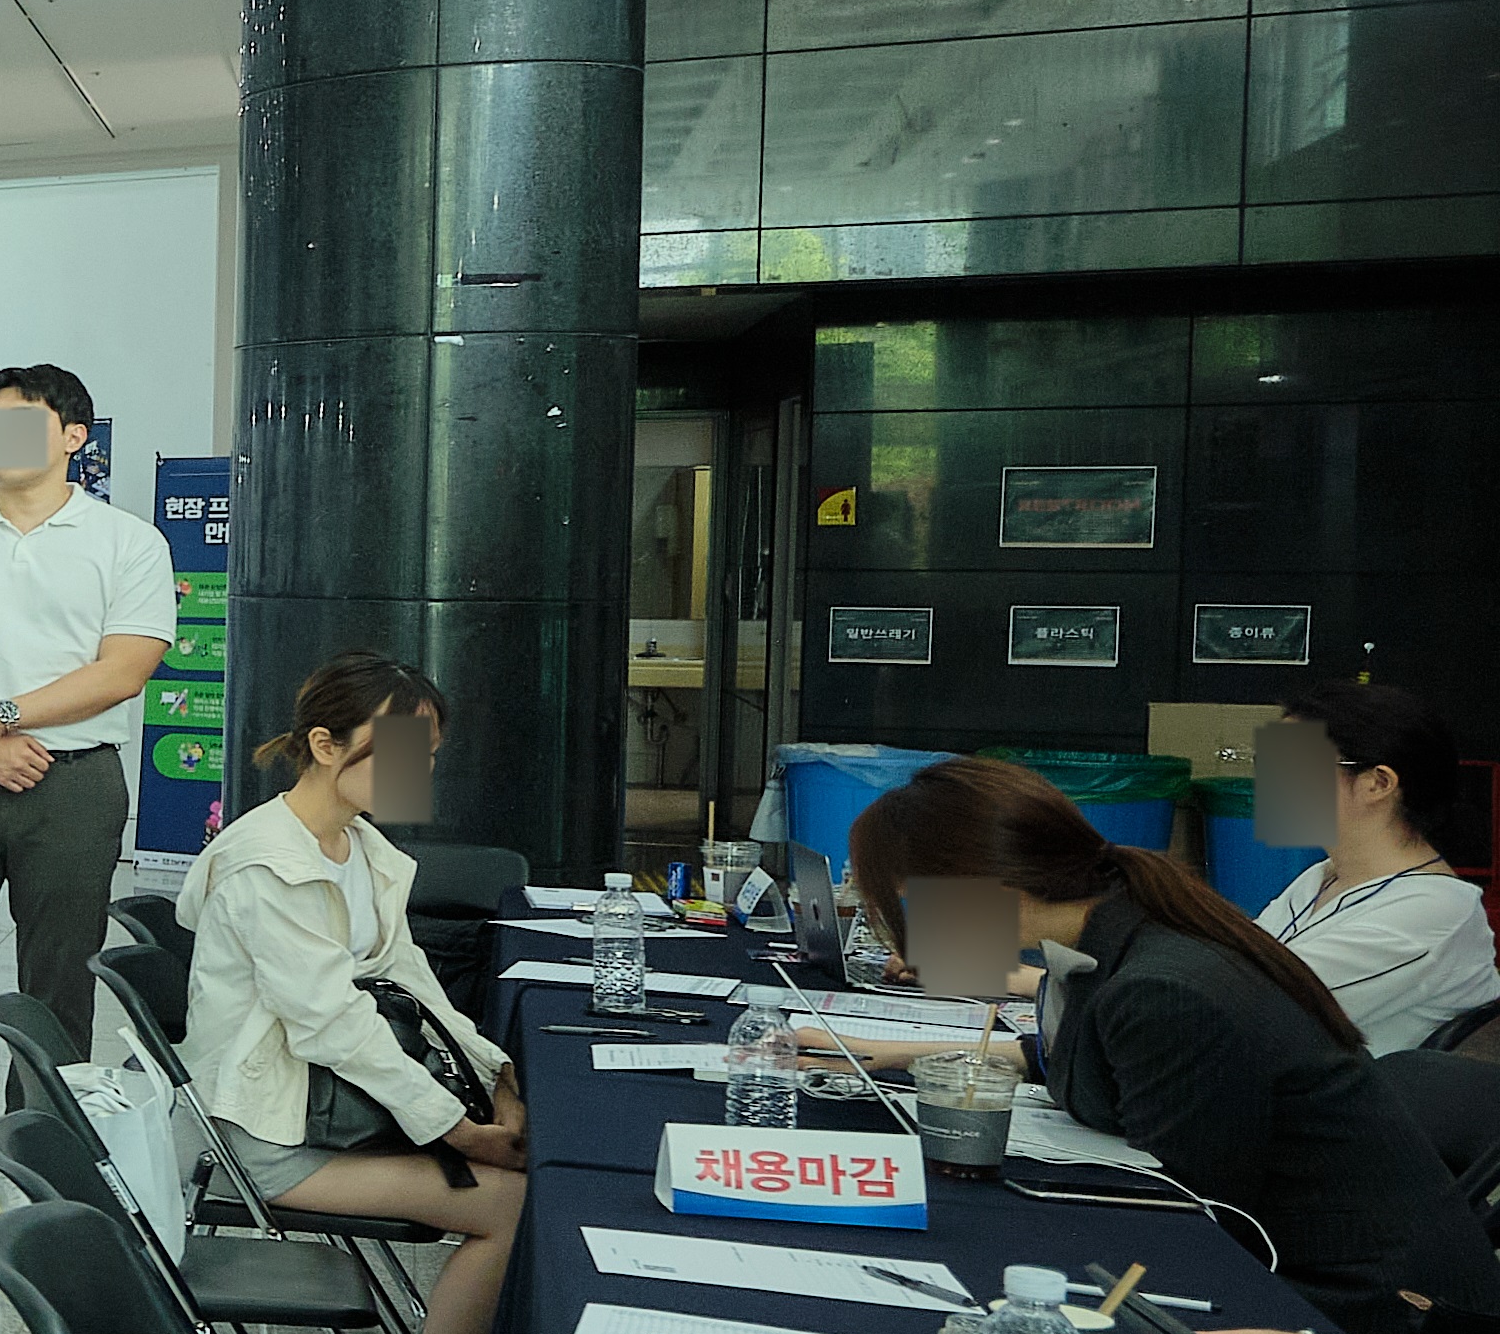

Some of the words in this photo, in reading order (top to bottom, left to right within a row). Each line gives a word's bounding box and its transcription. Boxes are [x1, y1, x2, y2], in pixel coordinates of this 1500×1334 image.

[165, 497, 205, 519] 현장
[845, 627, 916, 641] 일반쓰레기
[1035, 627, 1094, 640] 플라스틱
[1228, 625, 1276, 640] 종이류
[694, 1145, 899, 1199] 채용마감
